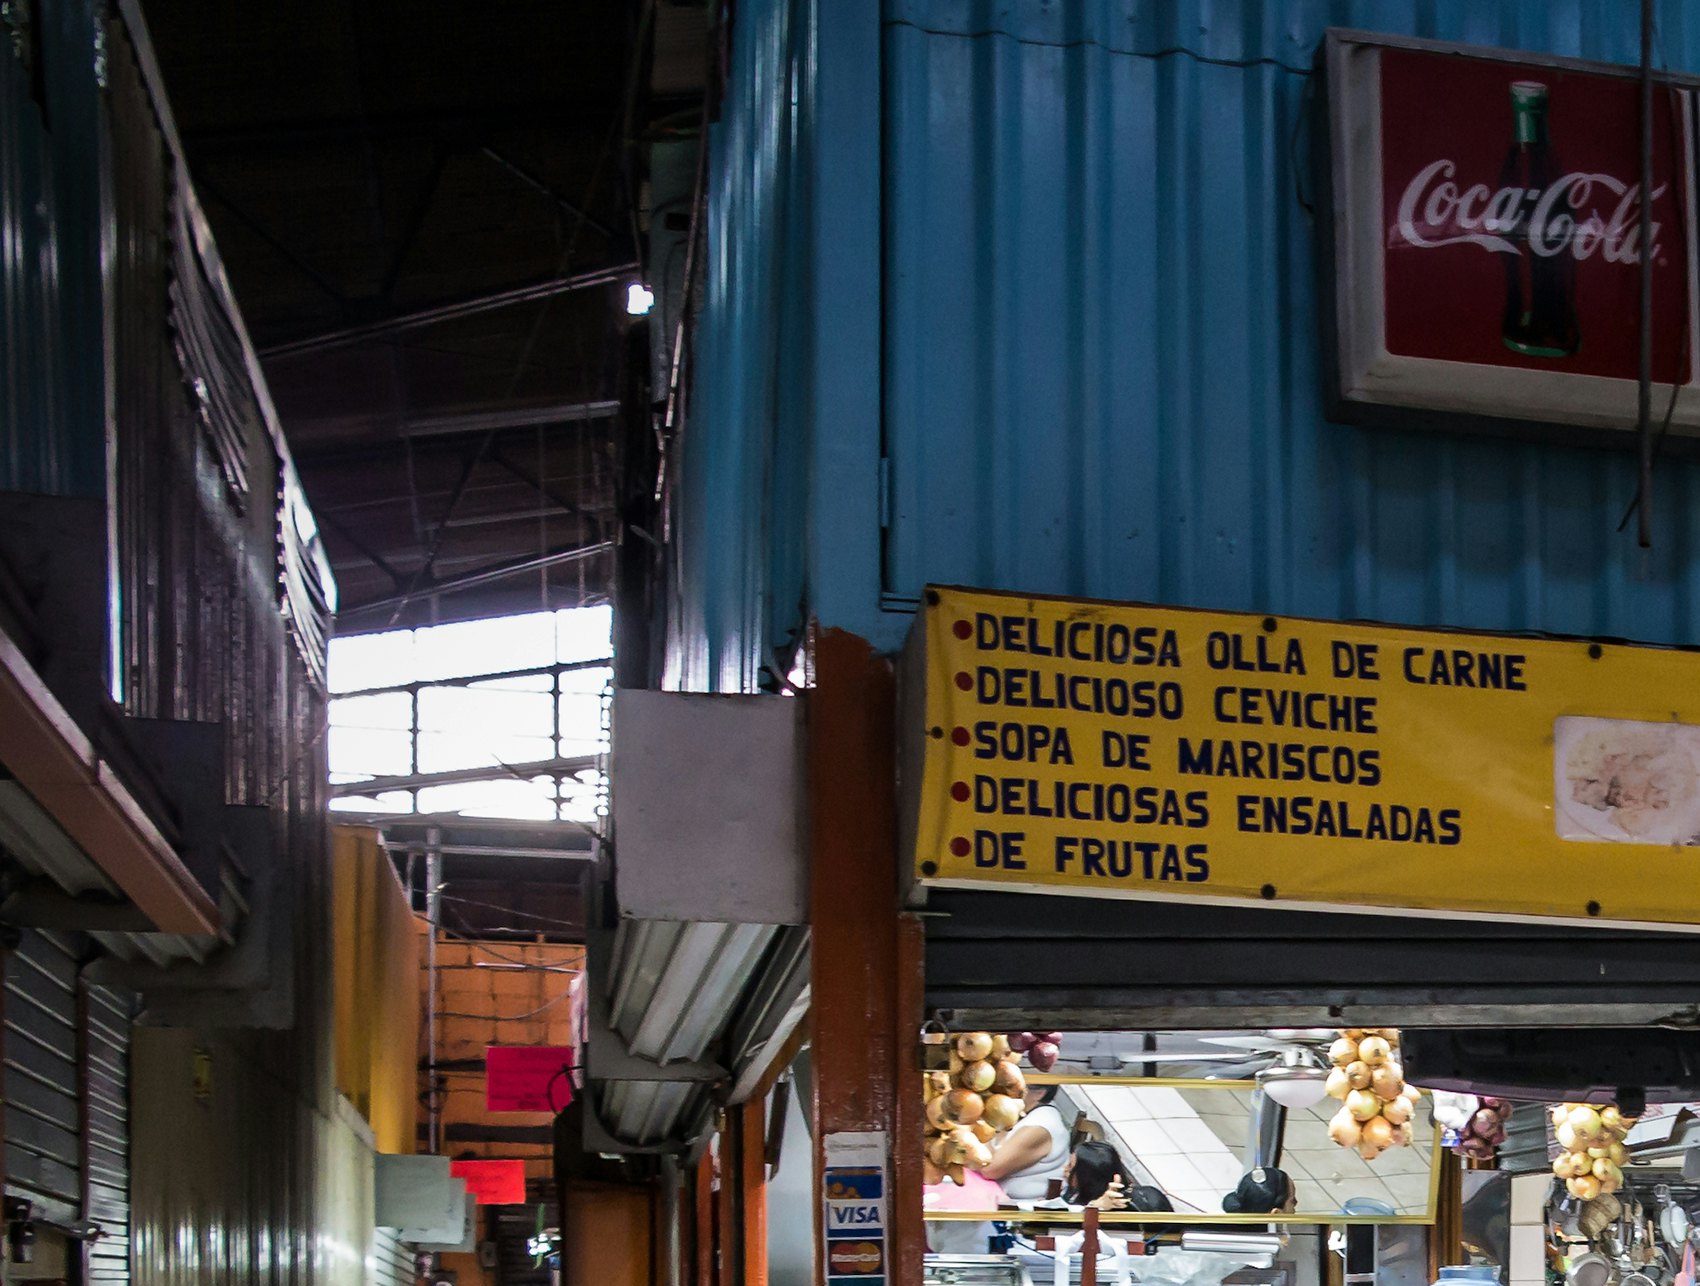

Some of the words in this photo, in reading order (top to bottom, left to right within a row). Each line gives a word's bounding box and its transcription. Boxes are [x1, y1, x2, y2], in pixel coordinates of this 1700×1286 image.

[975, 612, 1181, 668] DELICIOSA
[1206, 630, 1307, 676] OLLA
[1331, 639, 1380, 681] DE
[1403, 646, 1528, 692] CARNE
[975, 667, 1184, 721] DELICIOSO
[1214, 686, 1378, 735] CEVICHE
[974, 720, 1074, 766] SOPA
[1102, 731, 1151, 773] DE
[1177, 736, 1381, 787] MARISCOS
[974, 773, 1210, 829] DELICIOSAS
[1237, 794, 1462, 846] ENSALADAS
[974, 829, 1027, 871] DE
[1055, 835, 1210, 882] FRUTAS
[833, 1205, 881, 1225] VISA
